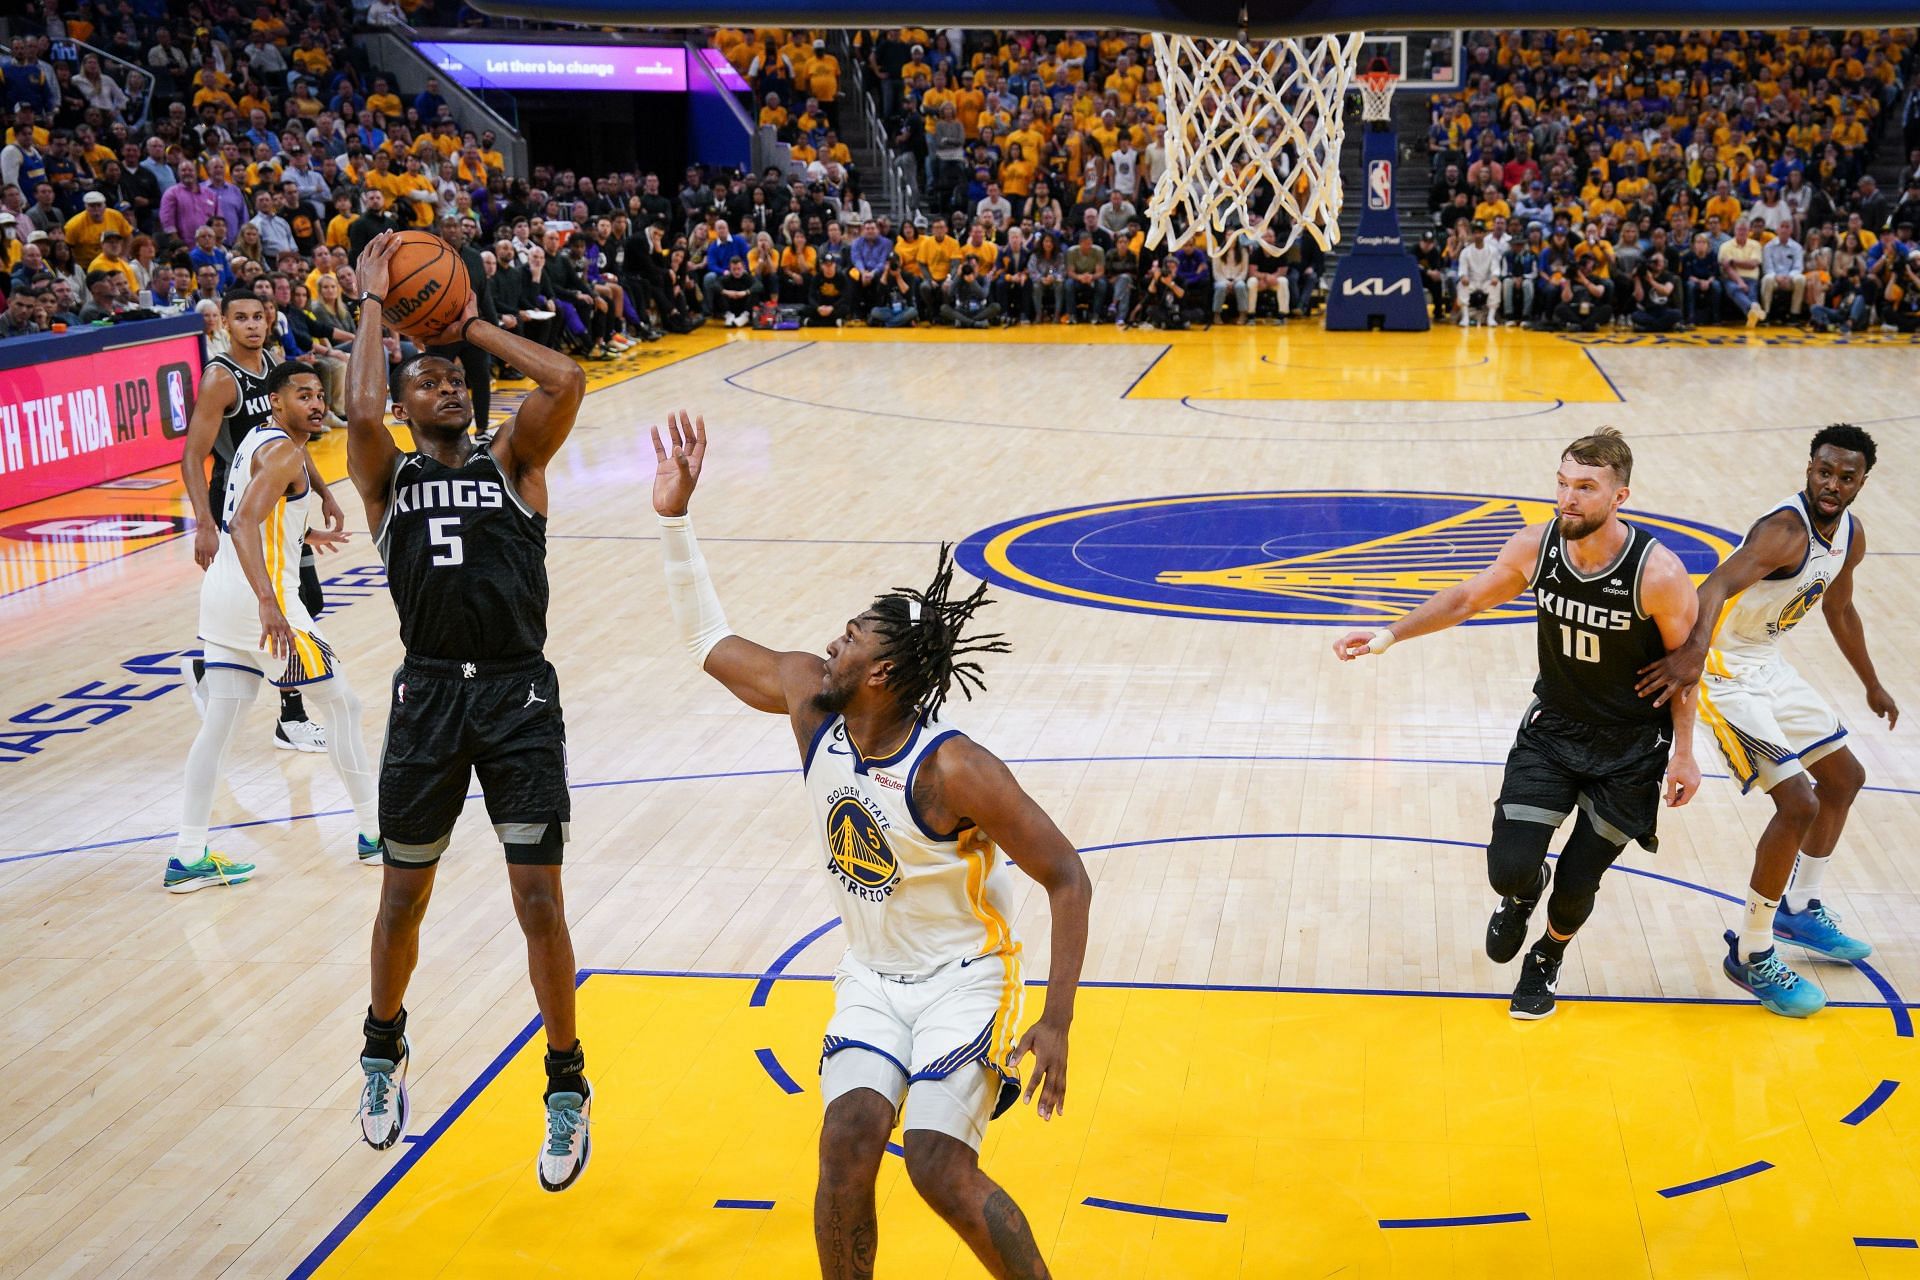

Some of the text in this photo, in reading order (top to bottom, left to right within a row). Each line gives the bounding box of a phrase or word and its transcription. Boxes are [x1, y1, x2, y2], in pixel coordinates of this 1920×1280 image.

[486, 59, 615, 77] Let there be change
[1357, 236, 1382, 246] Google
[384, 278, 442, 324] Wilson
[23, 394, 69, 467] THE
[67, 385, 114, 455] NBA
[114, 378, 151, 443] APP
[394, 480, 503, 516] KINGS
[428, 516, 464, 567] 5
[1548, 546, 1558, 559] 6
[1538, 587, 1632, 631] KINGS
[1602, 587, 1629, 596] dialpad
[1559, 623, 1601, 663] 10
[826, 786, 892, 832] GOLDEN STATE
[866, 826, 881, 850] 5
[826, 857, 901, 903] WARRIORS
